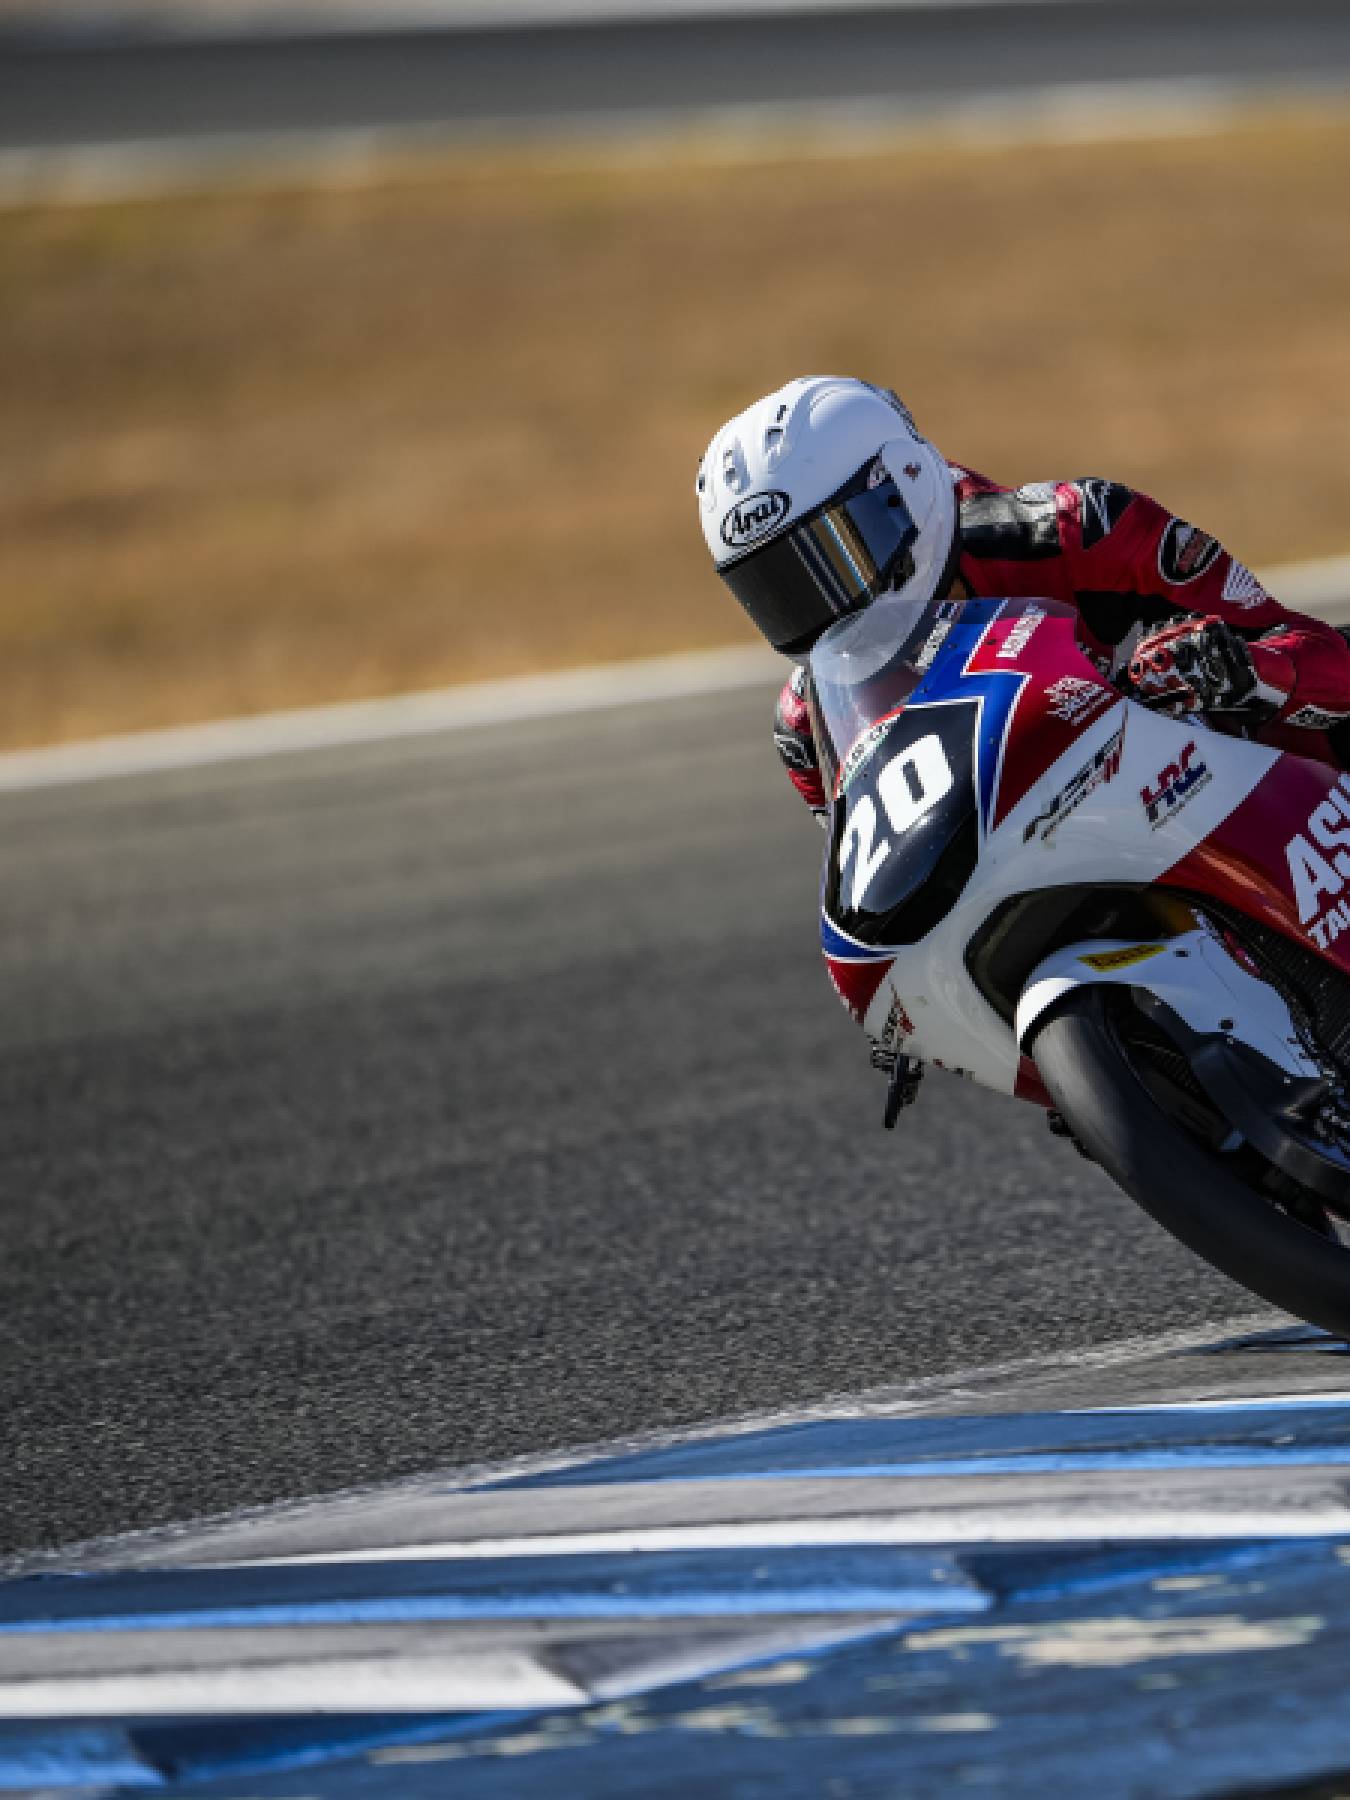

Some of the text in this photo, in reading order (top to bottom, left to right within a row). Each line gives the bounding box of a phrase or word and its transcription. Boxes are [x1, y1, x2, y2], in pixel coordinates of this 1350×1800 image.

[731, 497, 781, 534] Arai
[1141, 741, 1207, 823] HRC
[839, 735, 954, 912] 20
